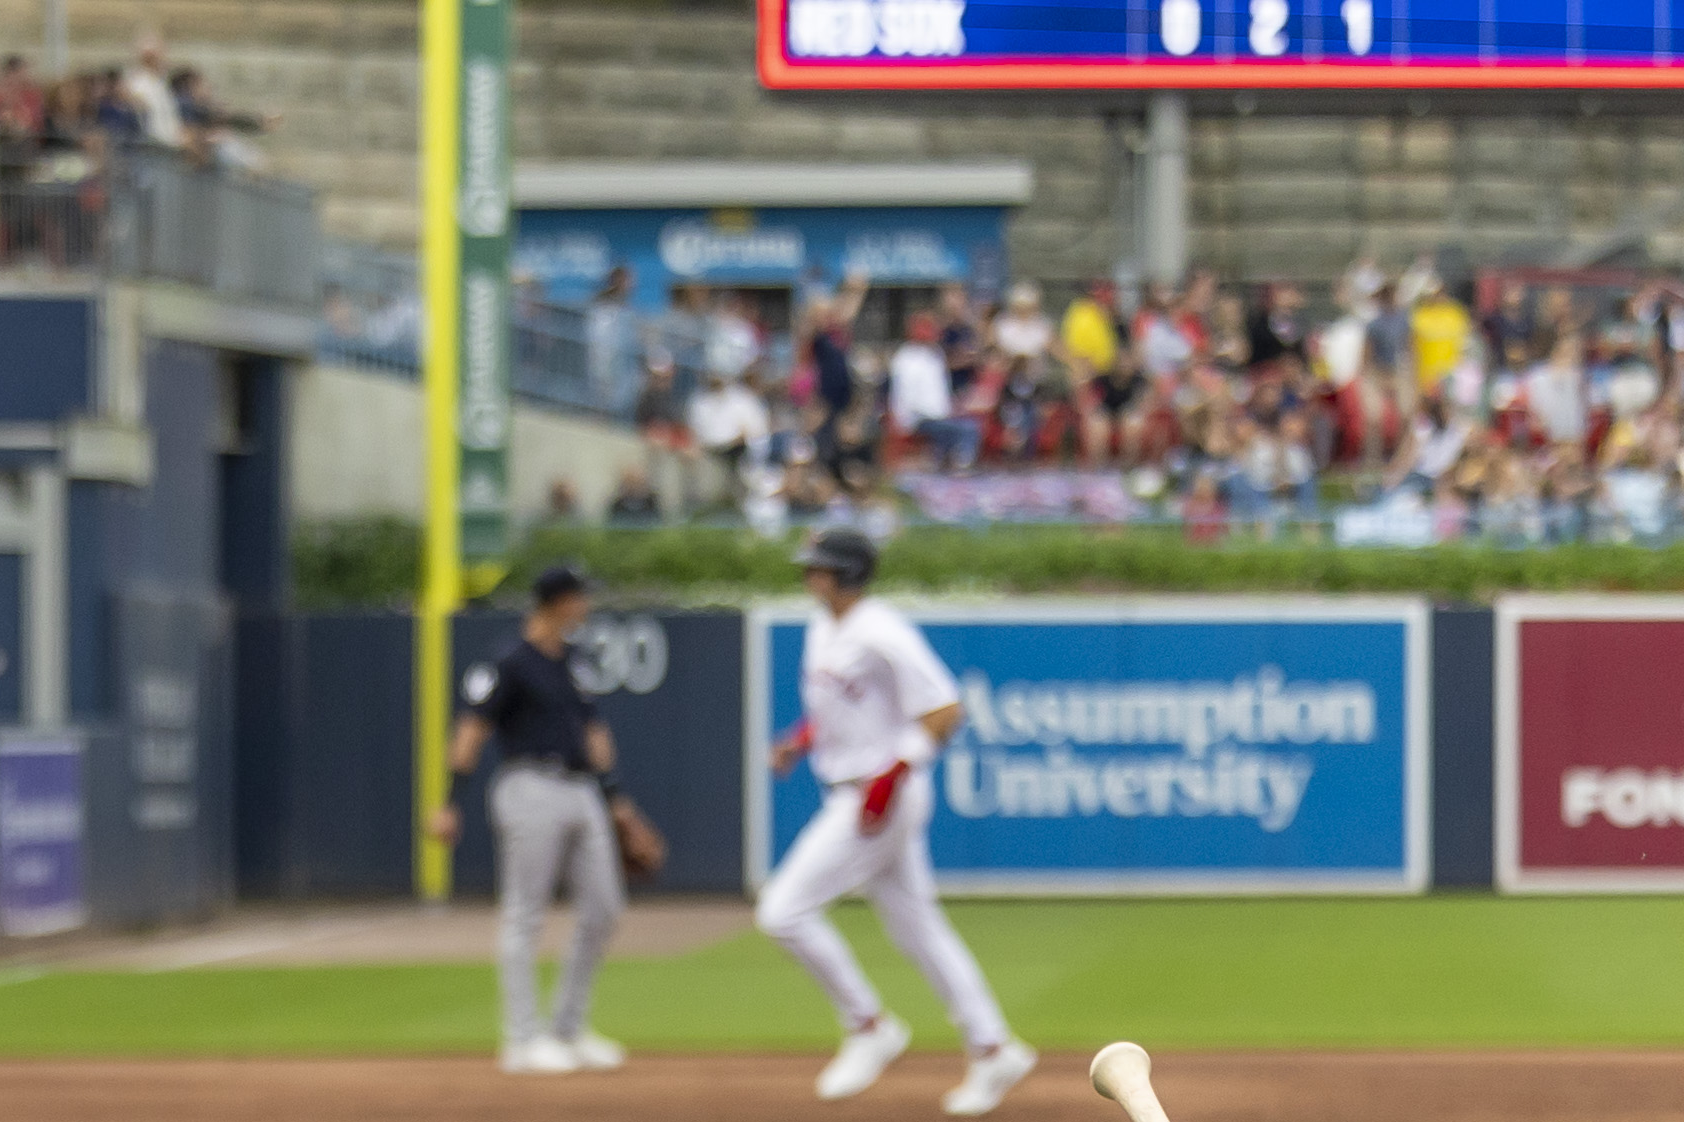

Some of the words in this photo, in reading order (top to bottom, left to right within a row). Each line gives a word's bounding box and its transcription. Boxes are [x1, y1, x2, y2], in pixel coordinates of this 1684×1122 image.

[1249, 0, 1290, 56] 2
[1340, 0, 1373, 56] 1
[958, 664, 1376, 760] Assumption
[944, 744, 1314, 832] University
